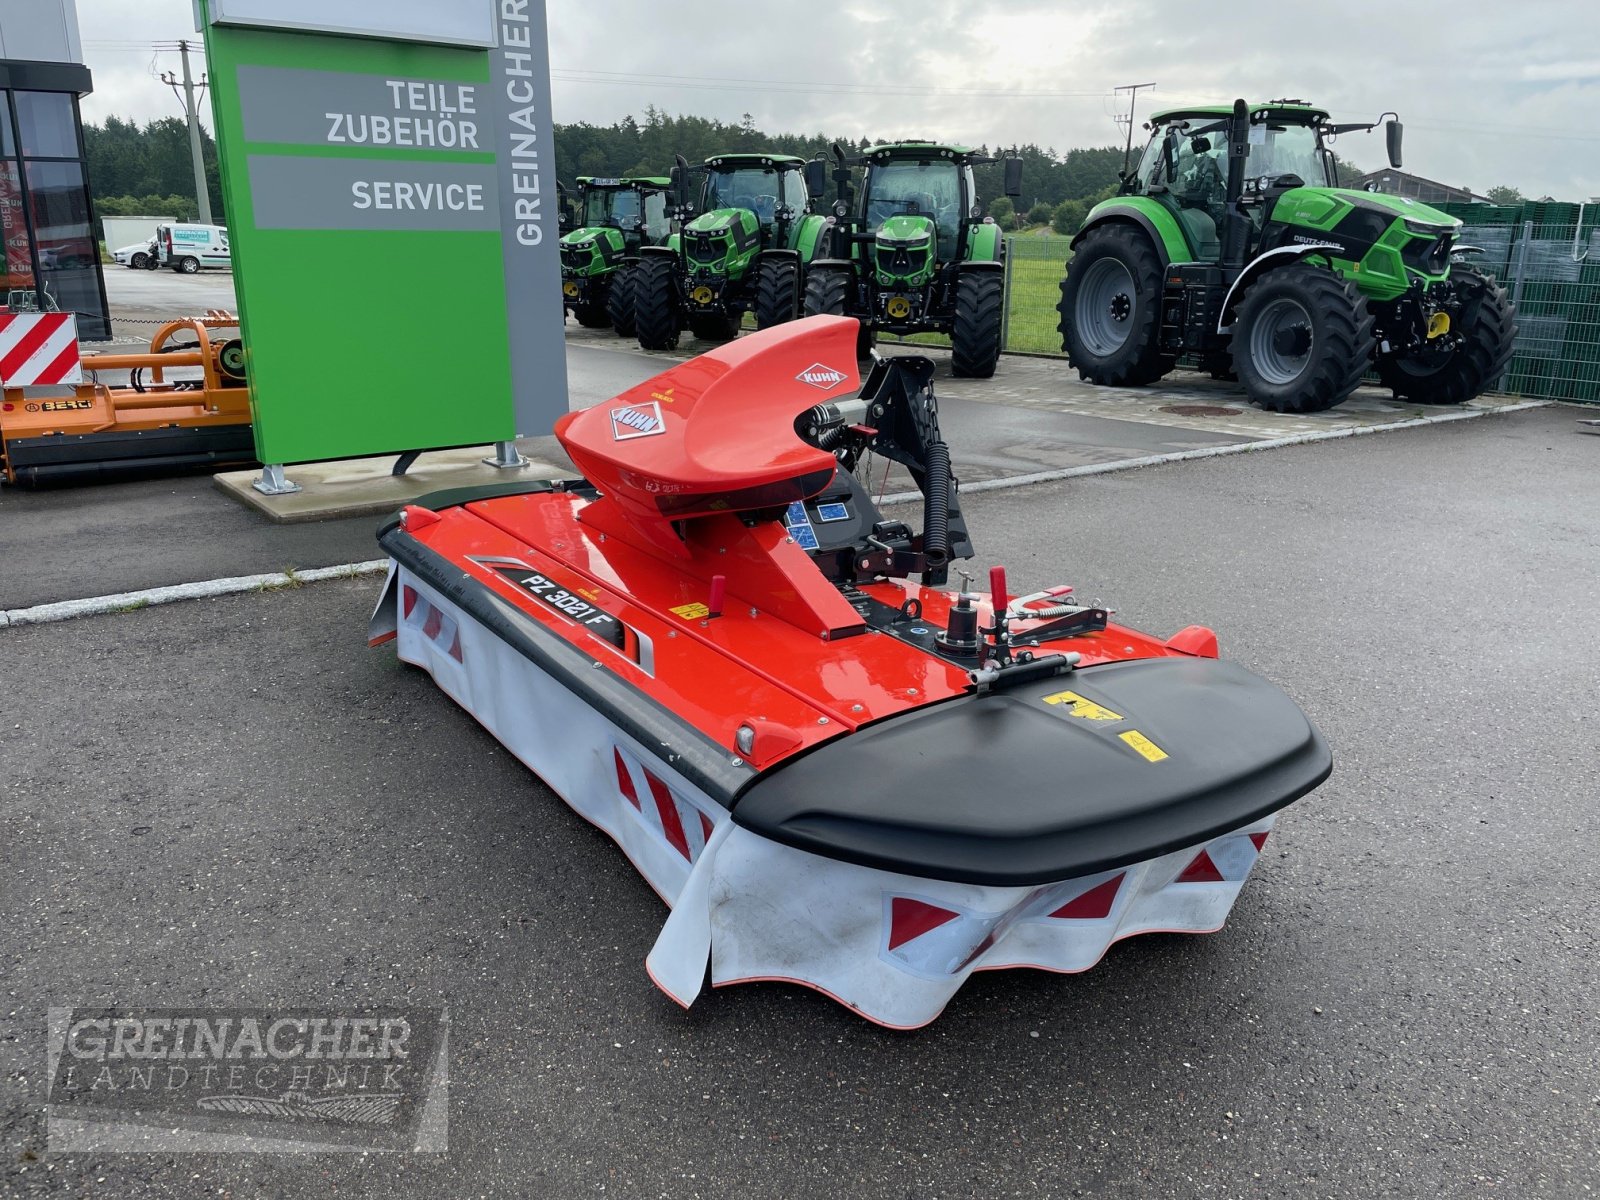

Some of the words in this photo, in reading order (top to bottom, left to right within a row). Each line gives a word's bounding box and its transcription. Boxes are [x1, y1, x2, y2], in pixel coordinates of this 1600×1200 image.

[386, 80, 476, 114] TEILE
[325, 113, 479, 149] ZUBEHÖR
[502, 0, 543, 246] GREINACHER
[351, 180, 484, 211] SERVICE
[803, 372, 840, 383] KUHN
[613, 408, 660, 432] KUHN
[520, 575, 556, 594] PZ
[544, 590, 597, 619] 3021
[584, 614, 614, 625] F
